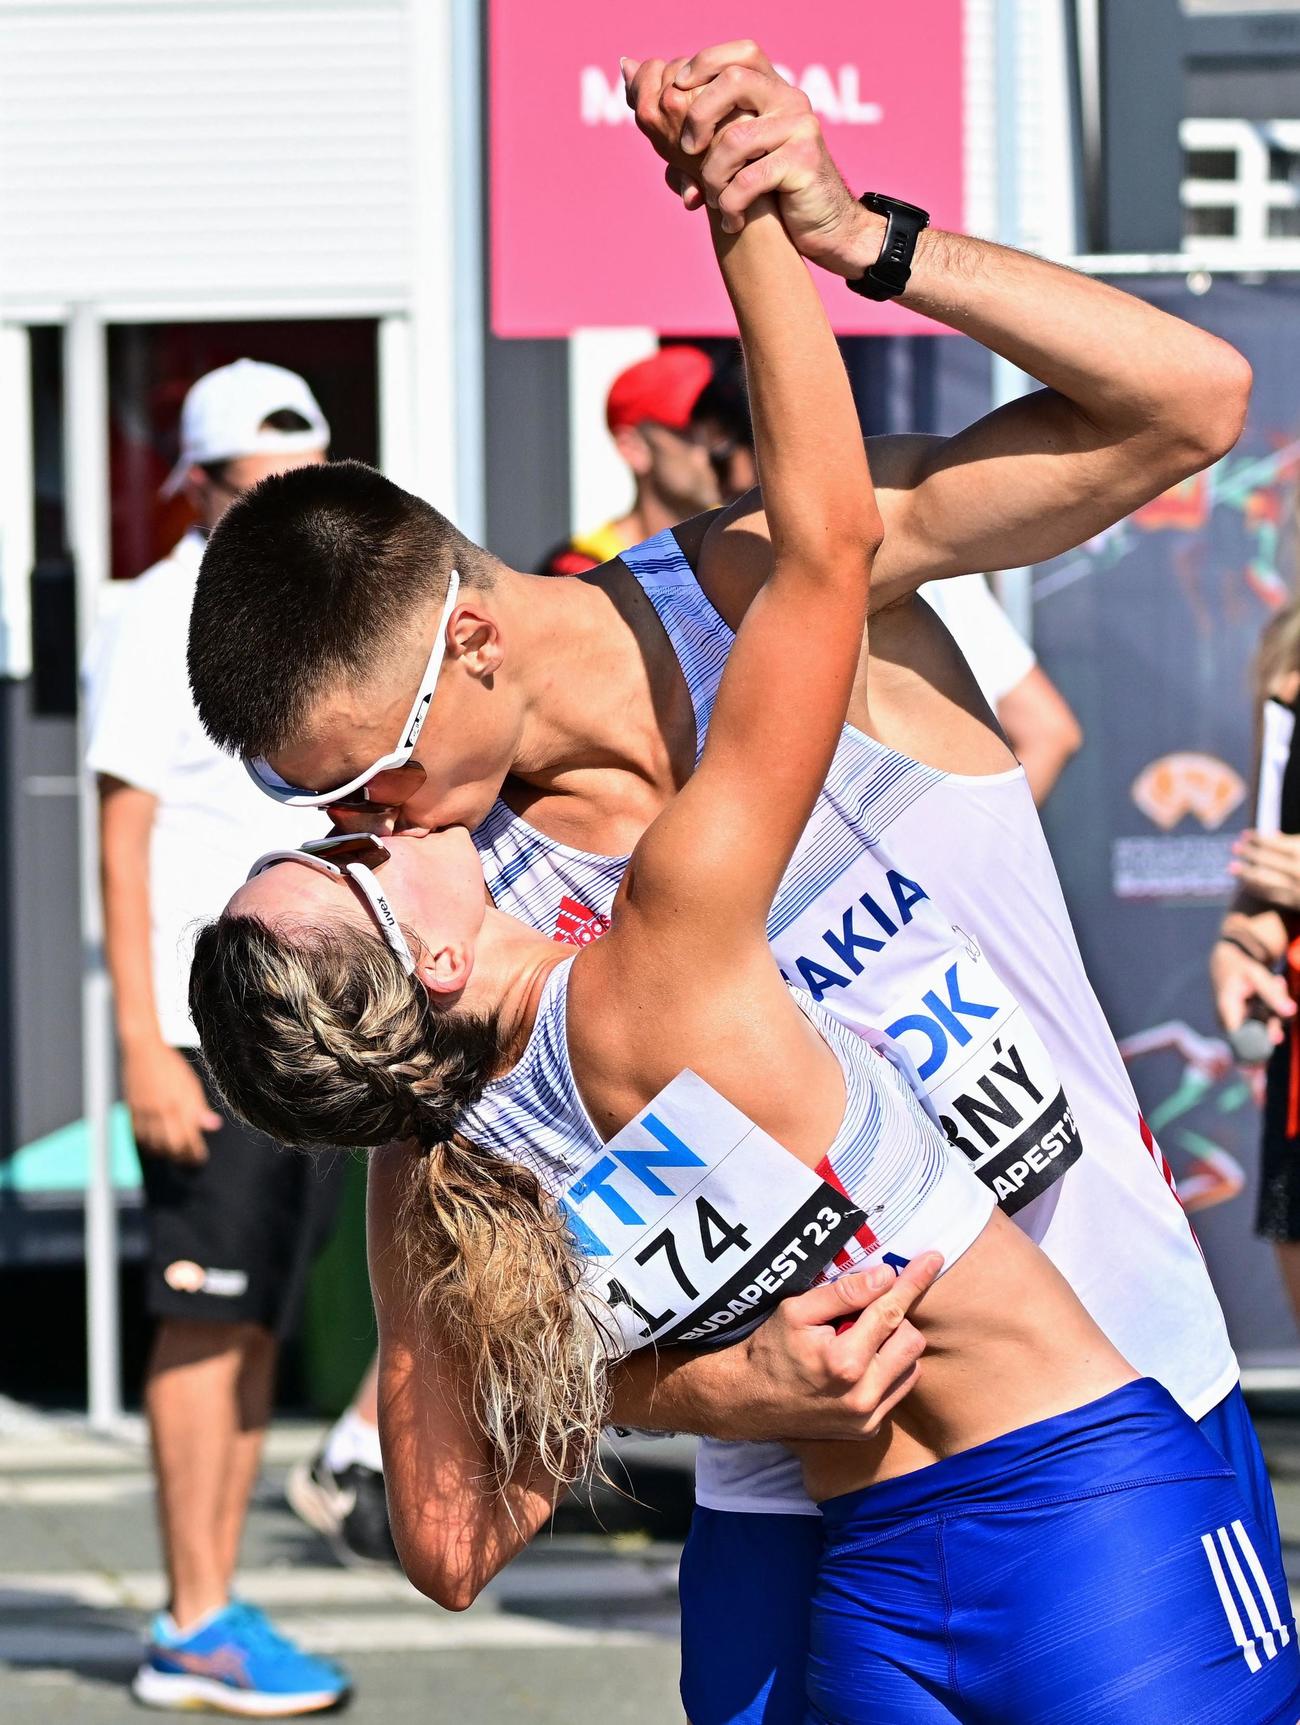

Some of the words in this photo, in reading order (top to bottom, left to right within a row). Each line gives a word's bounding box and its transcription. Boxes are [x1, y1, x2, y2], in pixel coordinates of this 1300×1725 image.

[377, 896, 396, 926] uvex
[780, 869, 930, 1002] AKIA
[884, 961, 1000, 1082] DK
[939, 1037, 1044, 1161] RNÝ
[992, 1119, 1071, 1201] APEST
[606, 1195, 751, 1338] 174
[677, 1237, 809, 1340] BUDAPEST
[803, 1206, 842, 1247] 23
